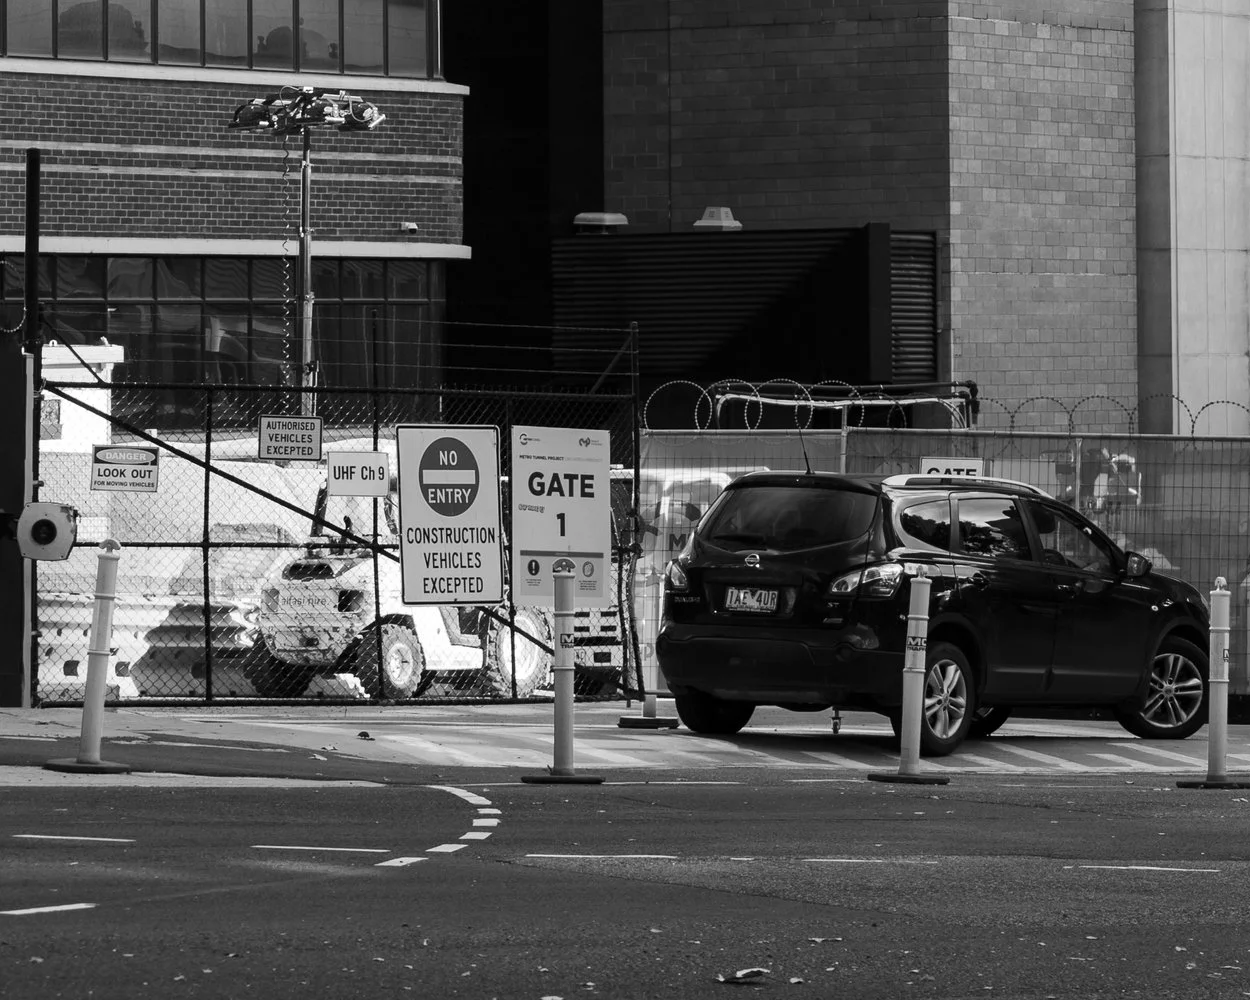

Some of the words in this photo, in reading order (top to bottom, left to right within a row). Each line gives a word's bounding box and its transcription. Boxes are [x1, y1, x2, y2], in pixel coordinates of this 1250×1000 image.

[266, 420, 317, 431] AUTHORISED
[268, 433, 314, 443] VEHICLES
[106, 452, 147, 461] DANGER
[266, 446, 314, 456] EXCEPTED
[439, 451, 458, 466] NO
[97, 468, 127, 478] LOOK
[131, 469, 153, 479] OUT
[333, 466, 356, 480] UHF
[361, 466, 375, 481] Ch
[378, 466, 385, 481] 9
[528, 471, 595, 498] GATE
[428, 488, 471, 504] ENTRY
[556, 513, 566, 537] 1
[406, 527, 495, 545] CONSTRUCTION
[423, 552, 482, 569] VEHICLES
[423, 577, 484, 594] EXCEPTED
